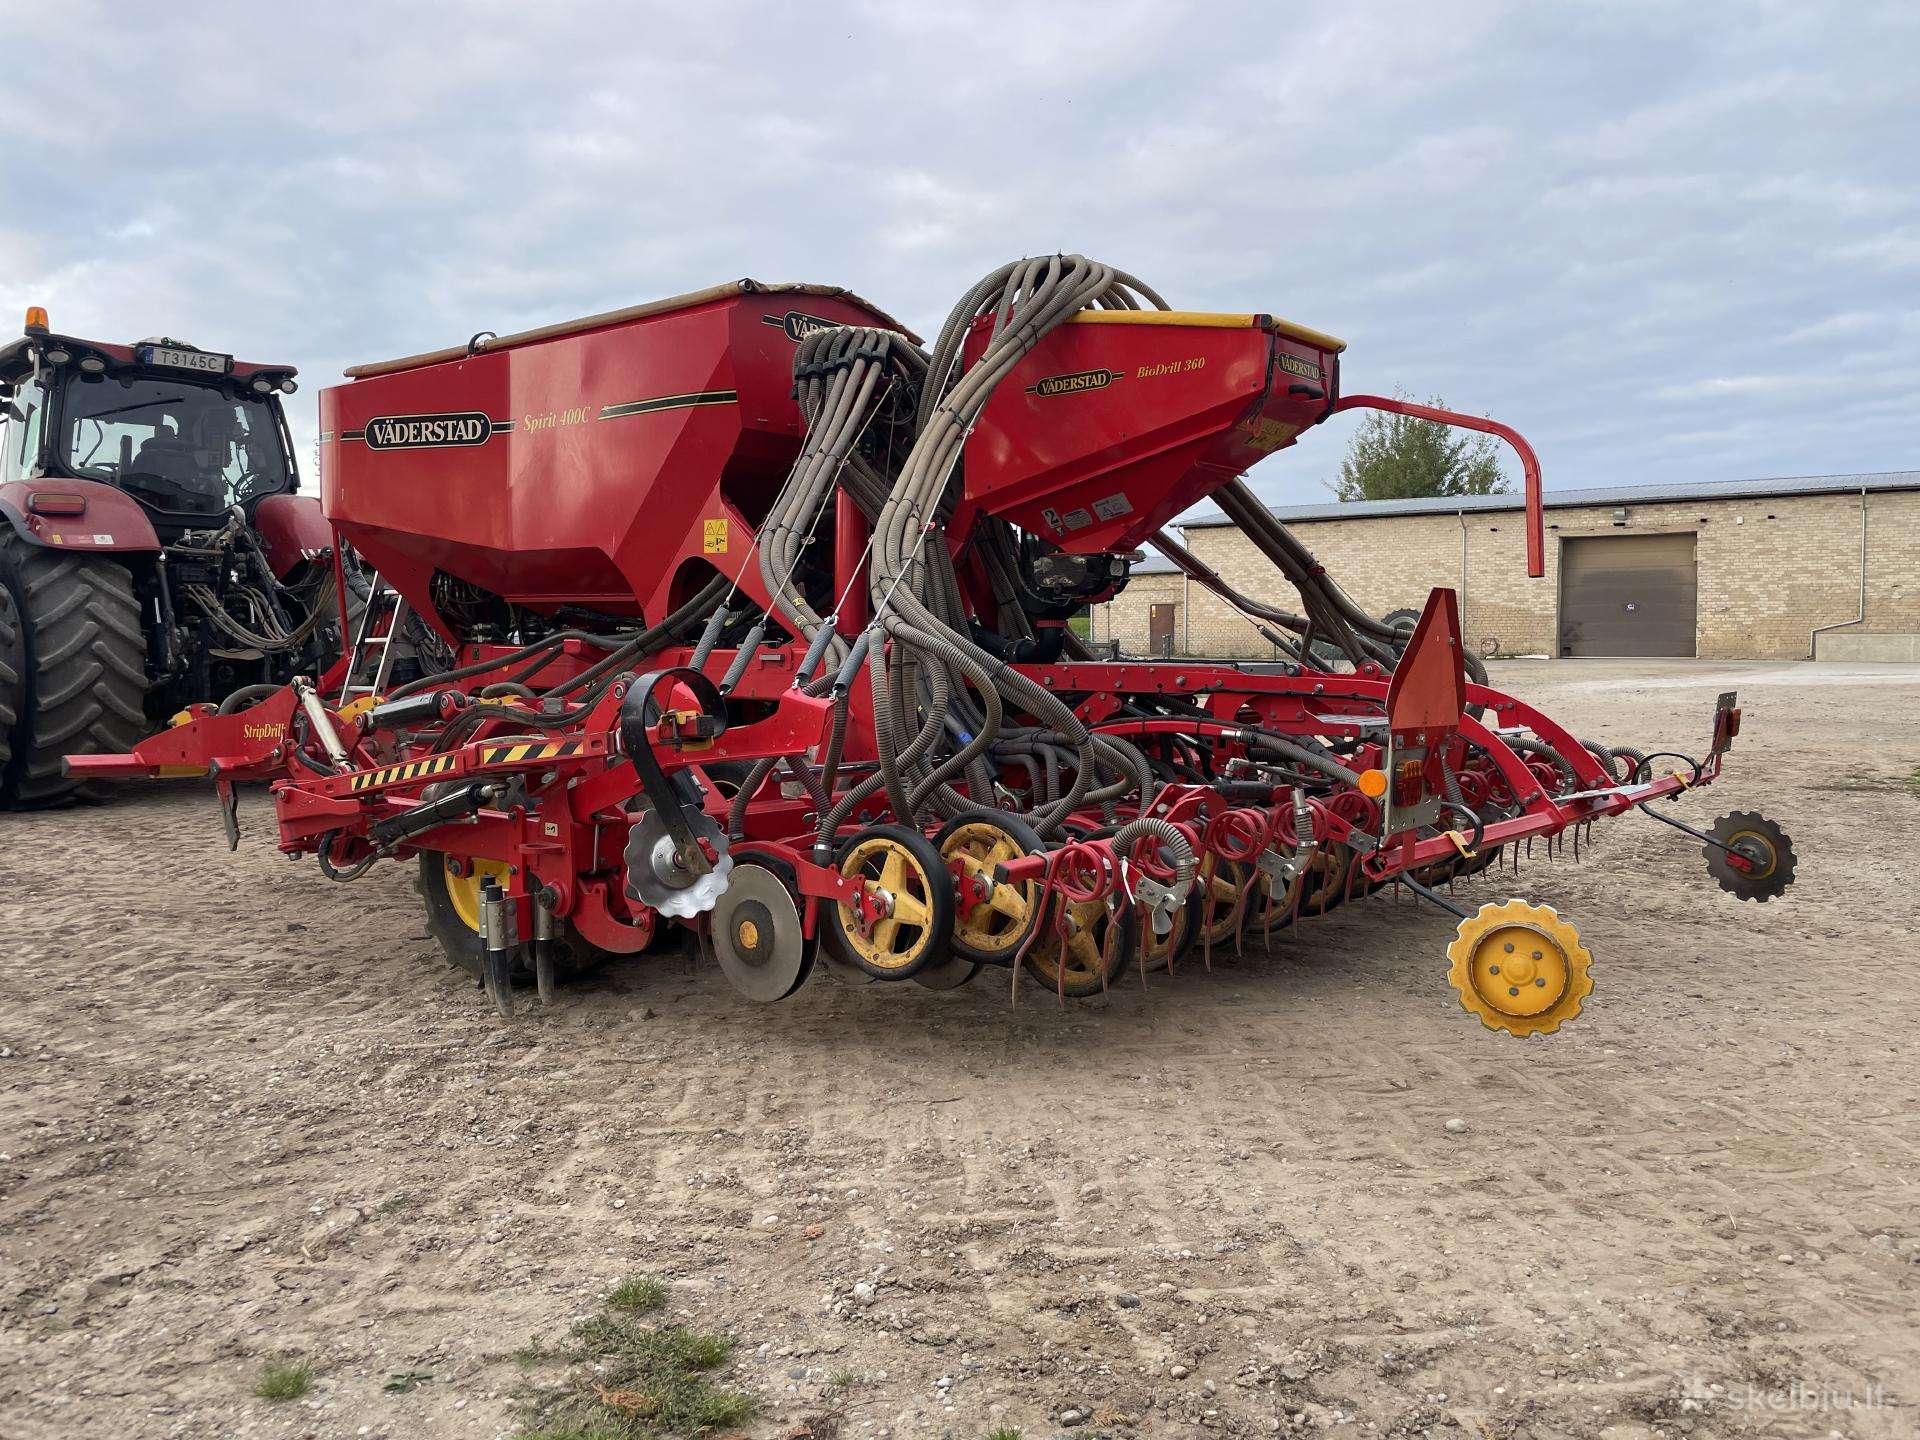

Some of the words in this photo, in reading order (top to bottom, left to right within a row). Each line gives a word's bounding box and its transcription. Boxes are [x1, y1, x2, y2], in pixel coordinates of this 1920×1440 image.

[161, 351, 217, 370] T3145C
[1137, 360, 1181, 378] BioDrill
[1183, 357, 1206, 371] 360
[1281, 354, 1320, 380] VÄDERSTAD
[1042, 373, 1107, 394] VÄDERSTAD
[523, 411, 557, 433] Spirit
[559, 406, 592, 426] 400C
[373, 418, 484, 445] VÄDERSTAD
[1044, 510, 1060, 525] 2
[243, 723, 284, 741] StripDrill
